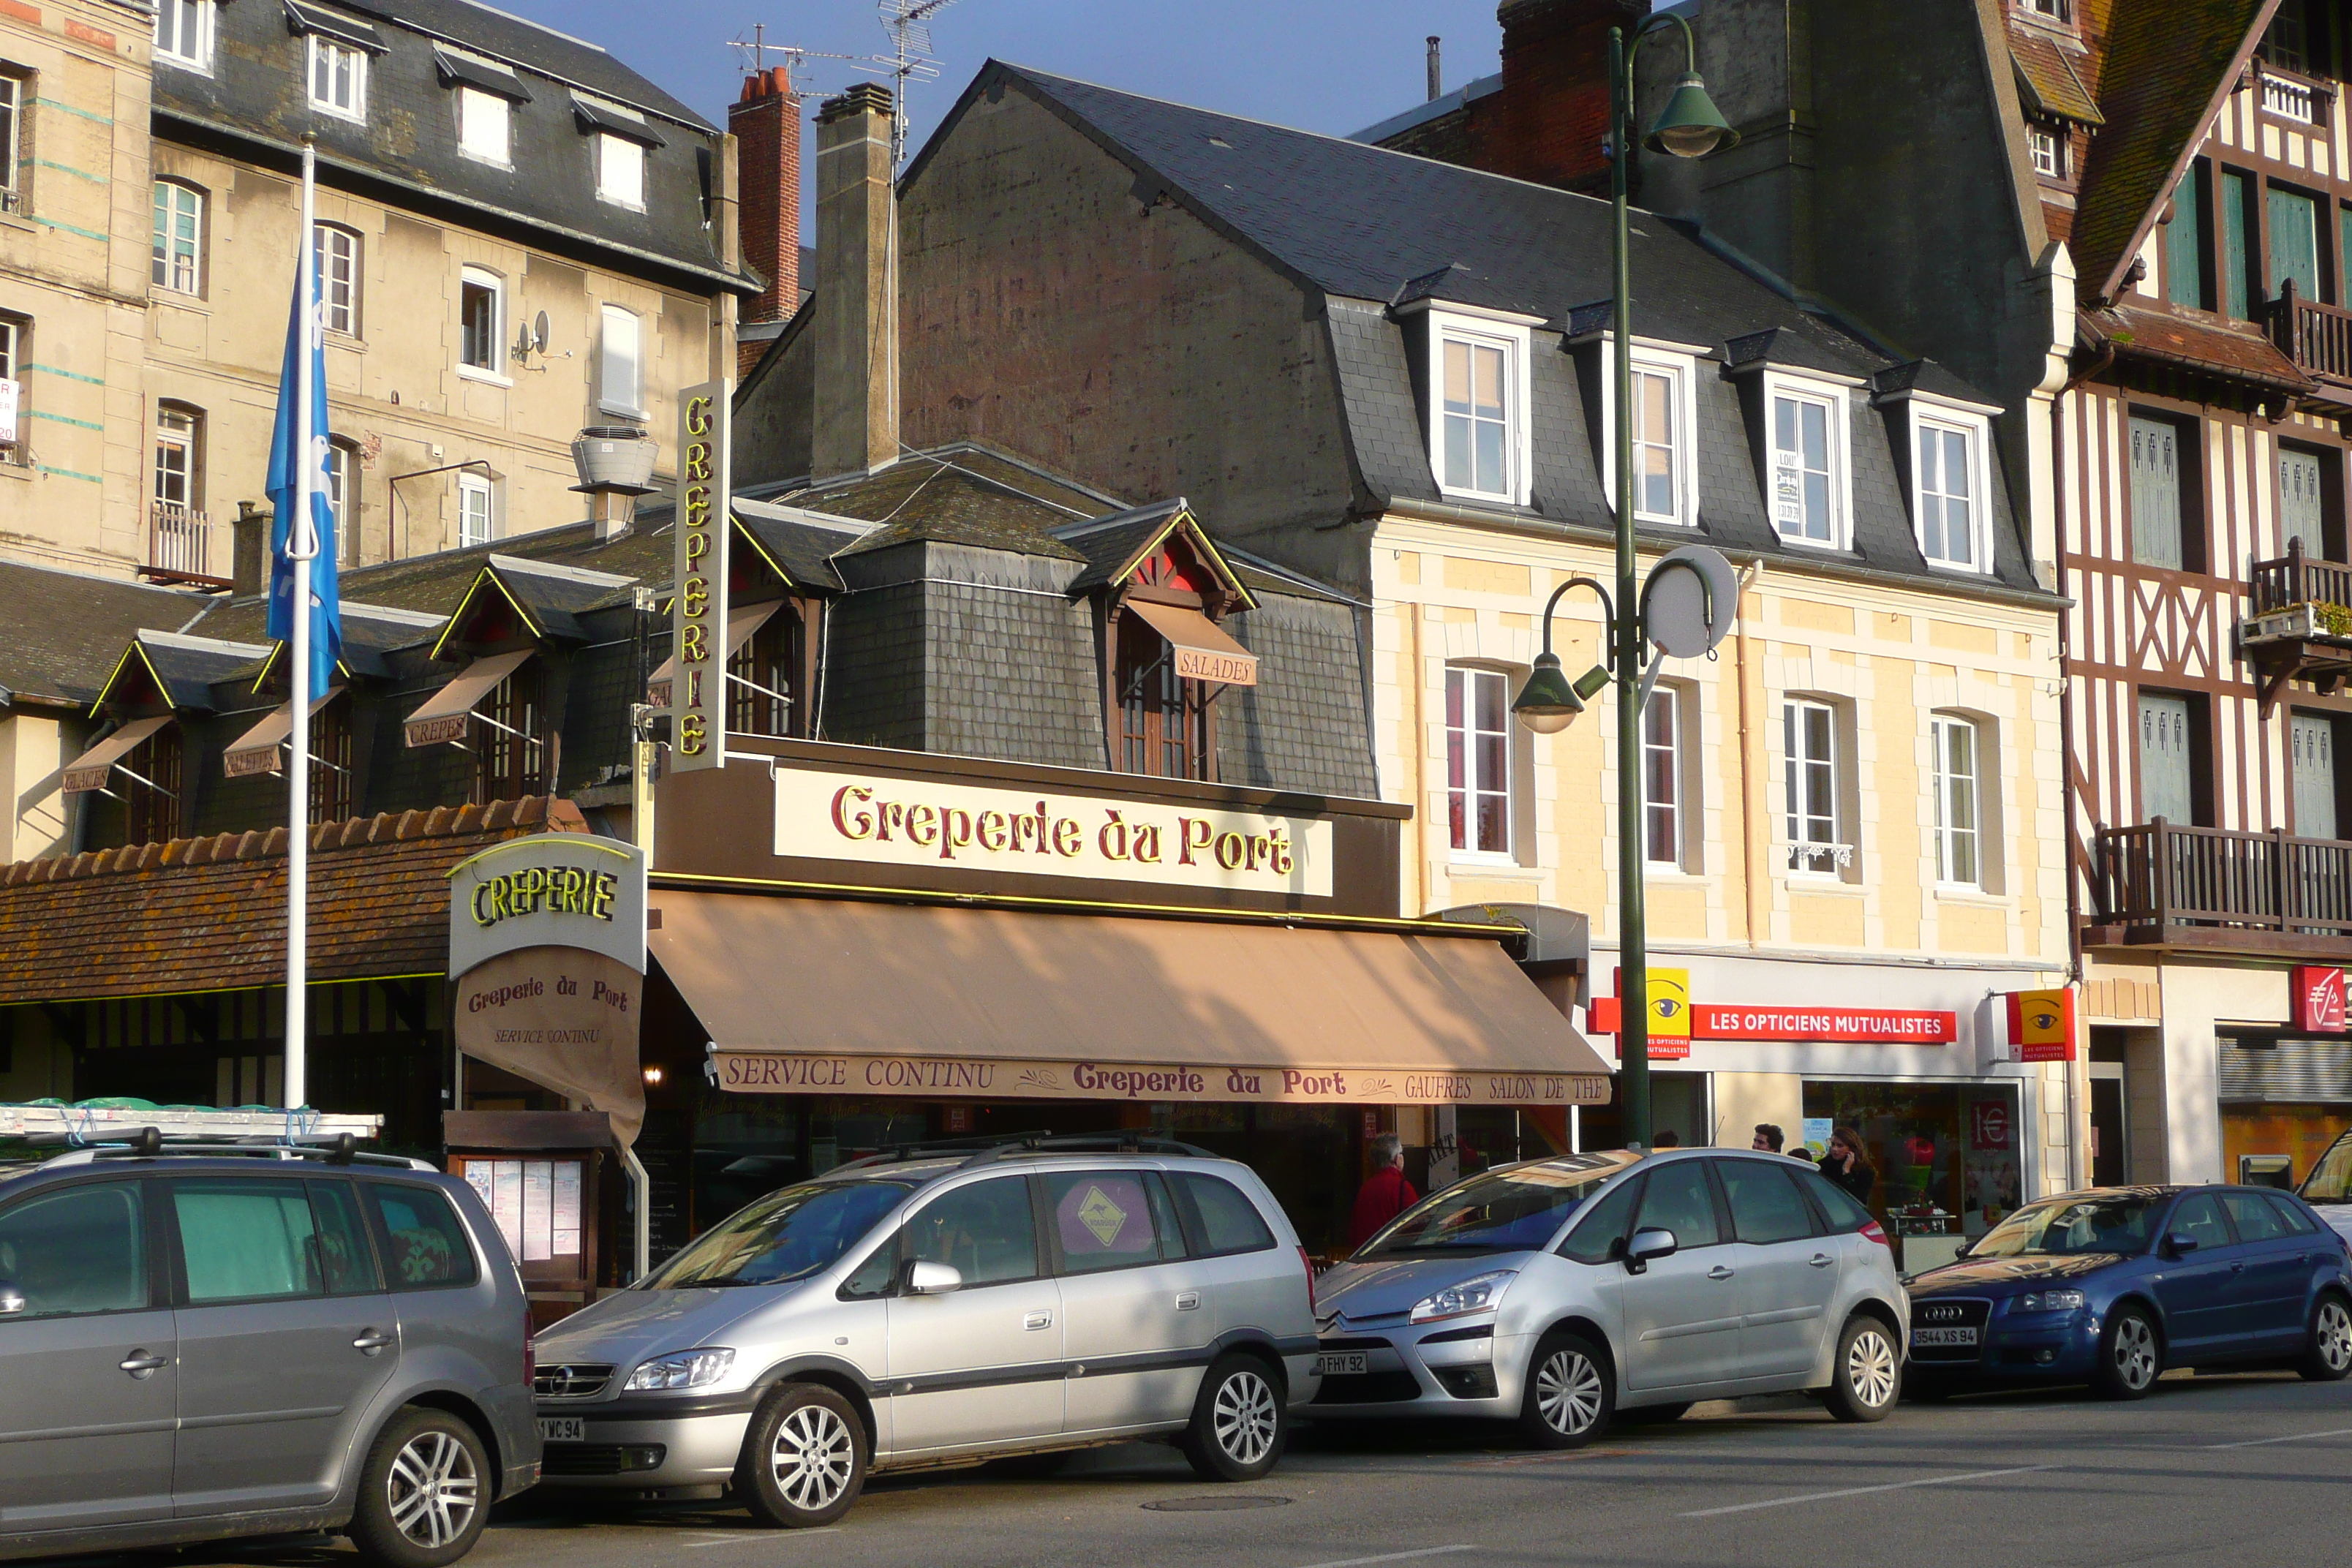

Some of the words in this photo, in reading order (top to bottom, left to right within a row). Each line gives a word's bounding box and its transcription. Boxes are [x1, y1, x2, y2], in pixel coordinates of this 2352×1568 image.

[1180, 653, 1251, 682] SALADES
[411, 717, 464, 744] CREPES
[66, 770, 108, 790] GLACES
[831, 785, 1083, 860] Creperie
[1098, 809, 1164, 864] du
[1178, 816, 1295, 876] Port
[471, 866, 618, 927] CREPERIE
[469, 977, 543, 1013] Creperie
[557, 976, 577, 995] du
[592, 980, 627, 1012] Port
[494, 1030, 544, 1043] SERVICE
[548, 1029, 600, 1044] CONTINU
[1711, 1013, 1739, 1030] LES
[1744, 1014, 1831, 1032] OPTICIENS
[1836, 1016, 1941, 1035] MUTUALISTES
[725, 1058, 847, 1085] SERVICE
[865, 1060, 995, 1088] CONTINU
[1073, 1062, 1205, 1097] Creperie
[1226, 1067, 1260, 1094] du
[1281, 1070, 1346, 1096] Port
[1405, 1075, 1471, 1099] GAUFRES
[1490, 1077, 1537, 1099] SALON
[1545, 1077, 1565, 1099] DE
[1572, 1078, 1602, 1099] THE
[1916, 1332, 1940, 1343] 3544
[1944, 1331, 1957, 1342] XS
[1961, 1330, 1974, 1342] 94
[1327, 1357, 1346, 1372] FHY
[1349, 1356, 1362, 1371] 92
[549, 1420, 562, 1438] WC
[565, 1420, 580, 1439] 94
